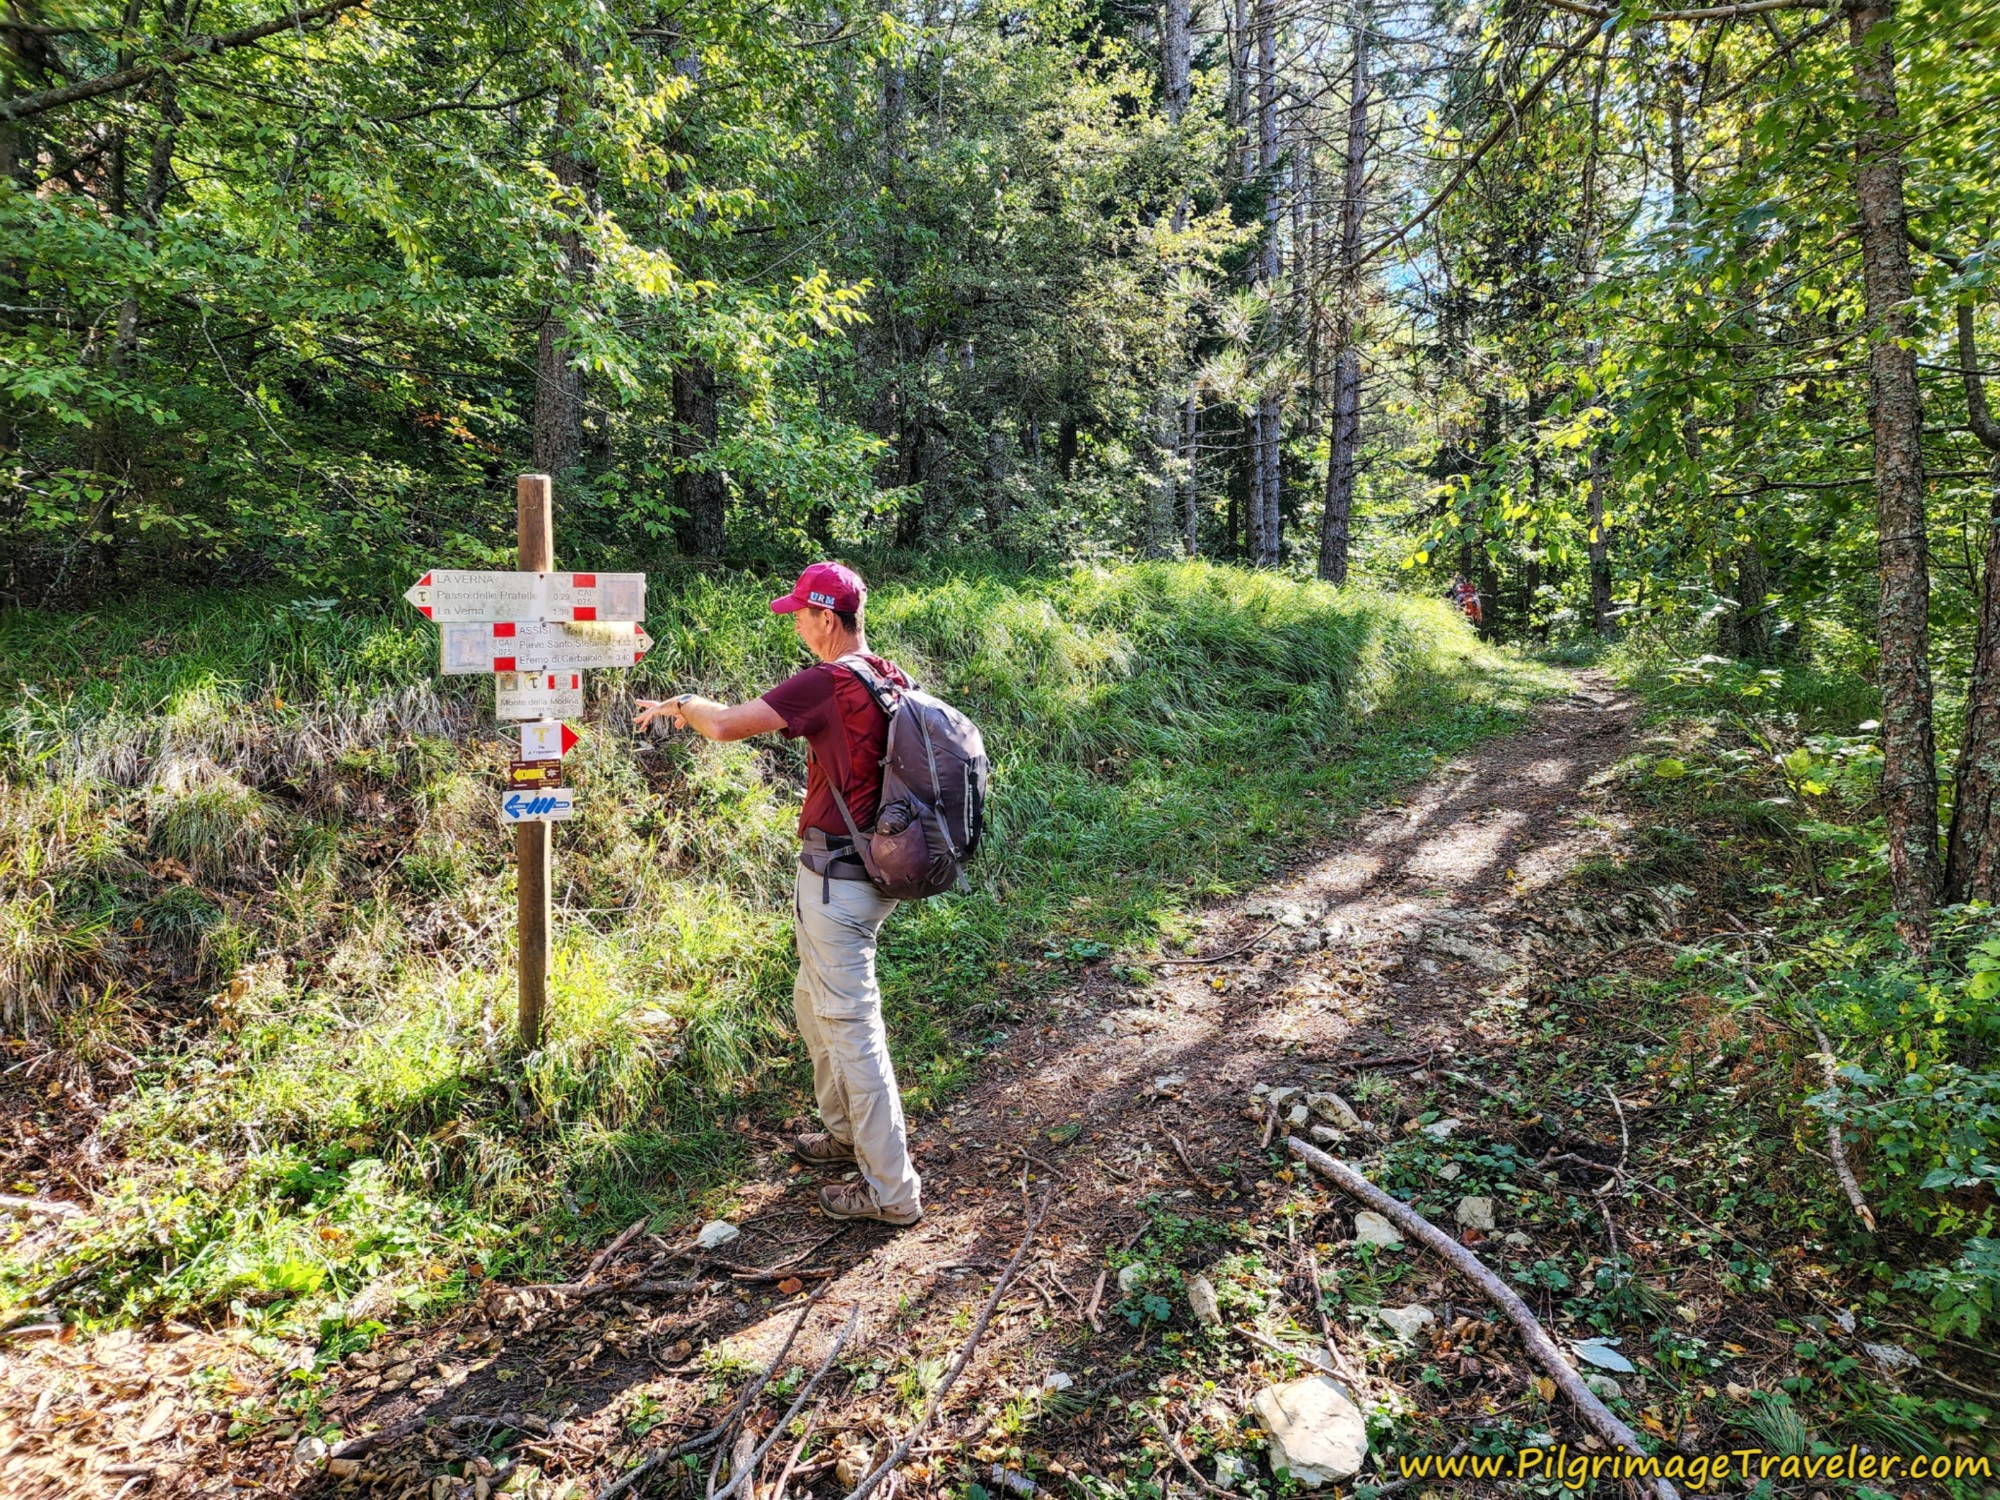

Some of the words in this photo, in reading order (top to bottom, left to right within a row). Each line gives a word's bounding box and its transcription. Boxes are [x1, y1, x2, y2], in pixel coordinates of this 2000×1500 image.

[437, 575, 453, 584] LA
[454, 575, 494, 584] VERNA
[437, 591, 470, 600] Passo
[472, 591, 497, 600] delle
[577, 589, 592, 597] CAI
[577, 598, 592, 606] 075
[810, 592, 835, 605] URM
[437, 607, 451, 615] La
[454, 607, 484, 615] Verna
[519, 625, 552, 635] ASSISI
[519, 640, 545, 649] Pieve
[547, 640, 573, 649] Santo
[498, 648, 512, 656] 075
[519, 655, 549, 665] Eremo
[551, 654, 559, 663] di
[561, 654, 602, 663] Cerbaiolo
[500, 697, 526, 706] Monte
